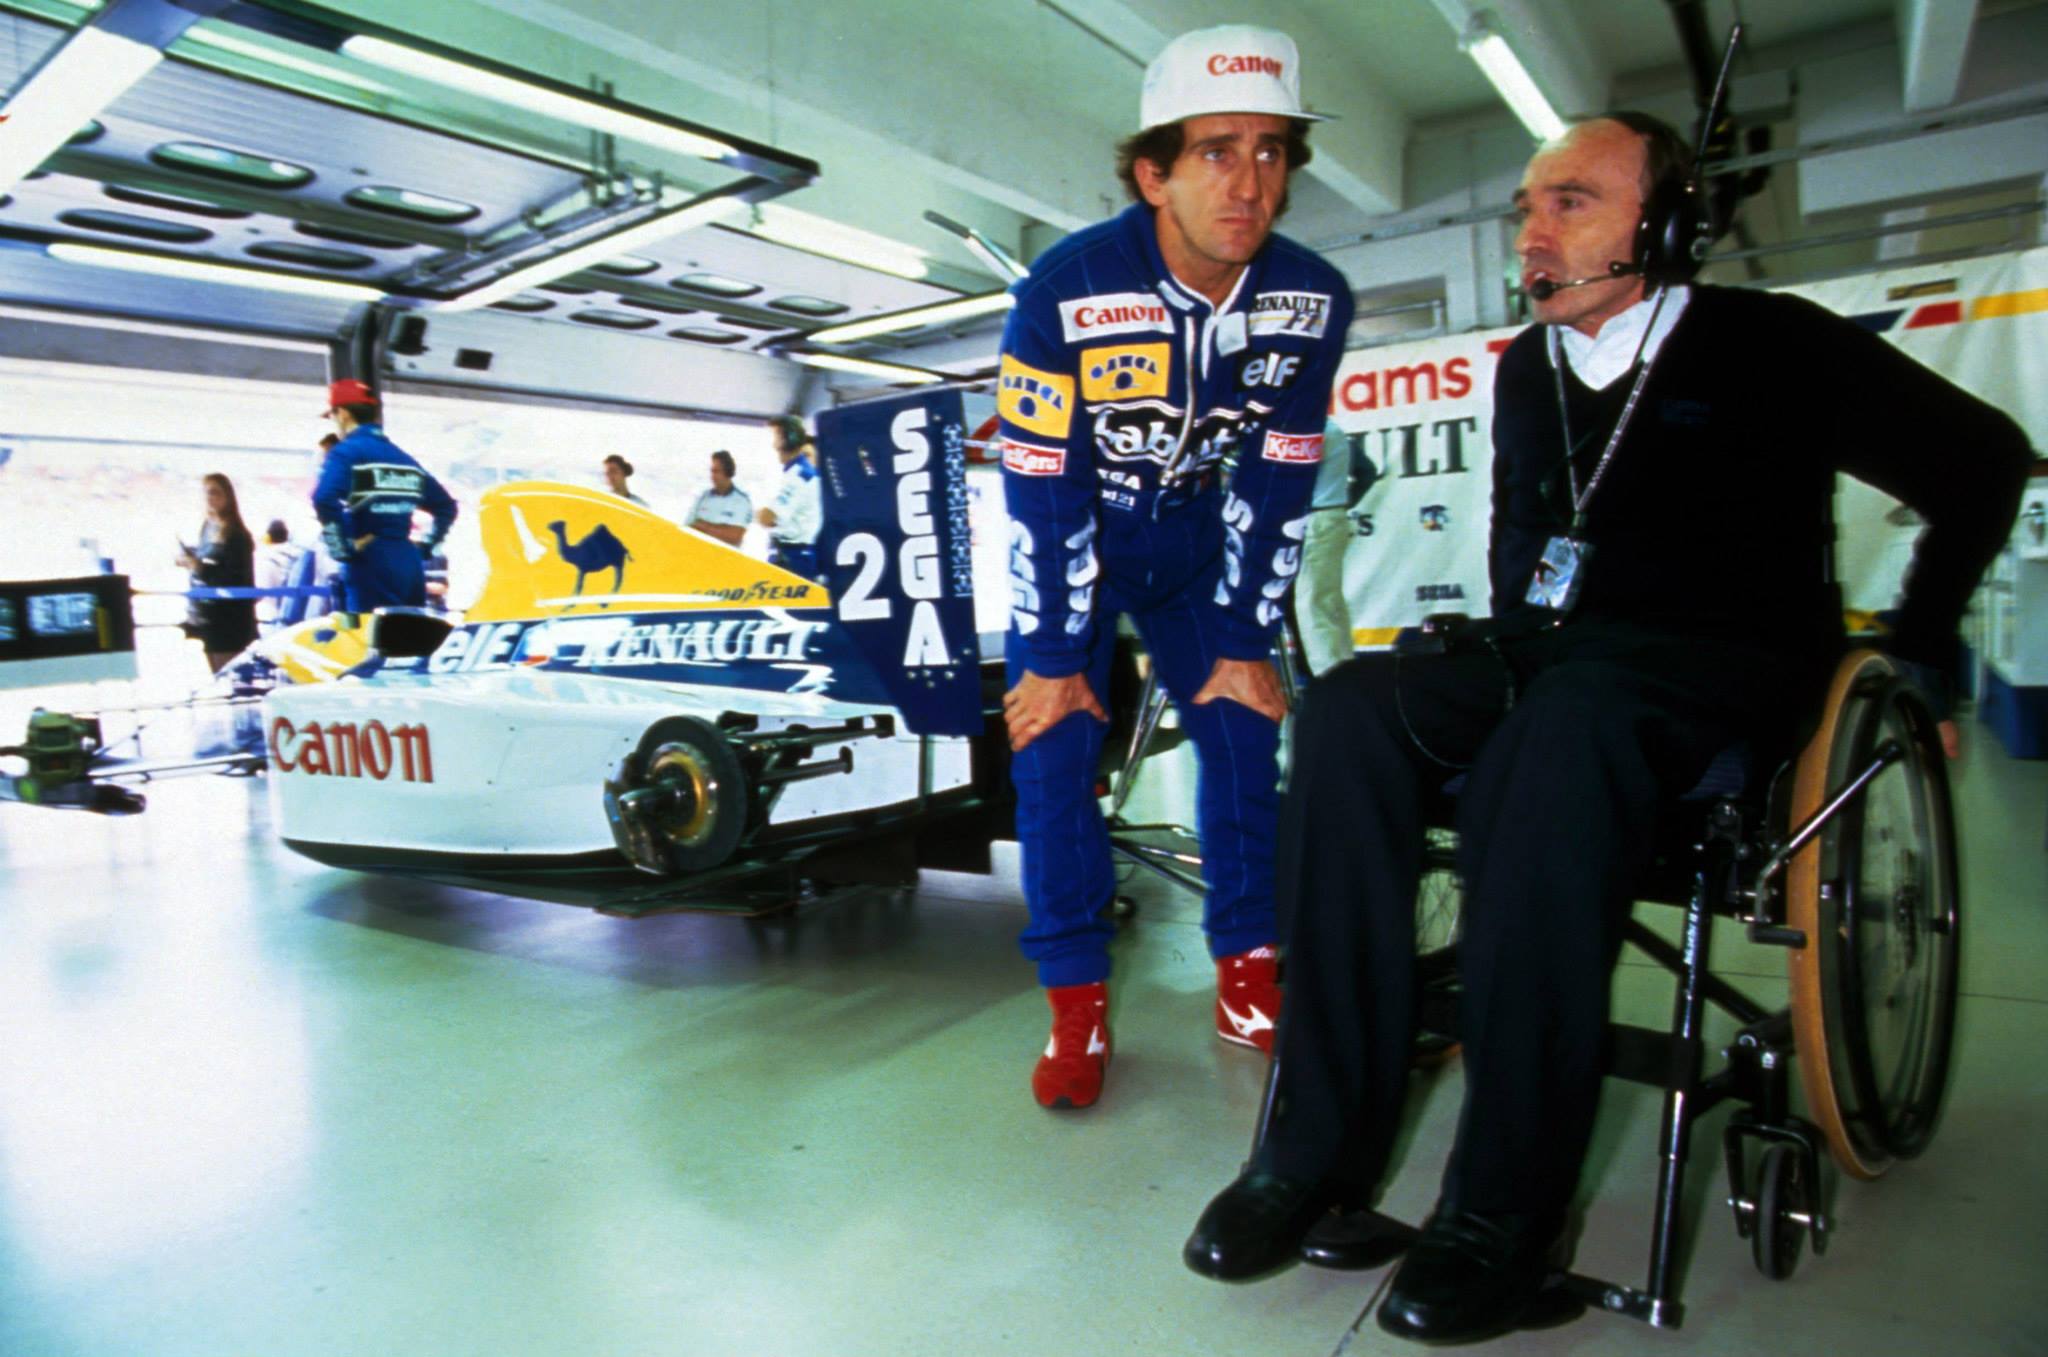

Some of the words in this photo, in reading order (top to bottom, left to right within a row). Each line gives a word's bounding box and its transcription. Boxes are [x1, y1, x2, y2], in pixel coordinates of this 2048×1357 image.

[1074, 305, 1165, 329] Canon
[1253, 294, 1327, 314] ENAULT
[1241, 352, 1301, 388] elf
[890, 407, 952, 667] SEGA
[836, 532, 892, 622] 2
[271, 715, 434, 784] Canon
